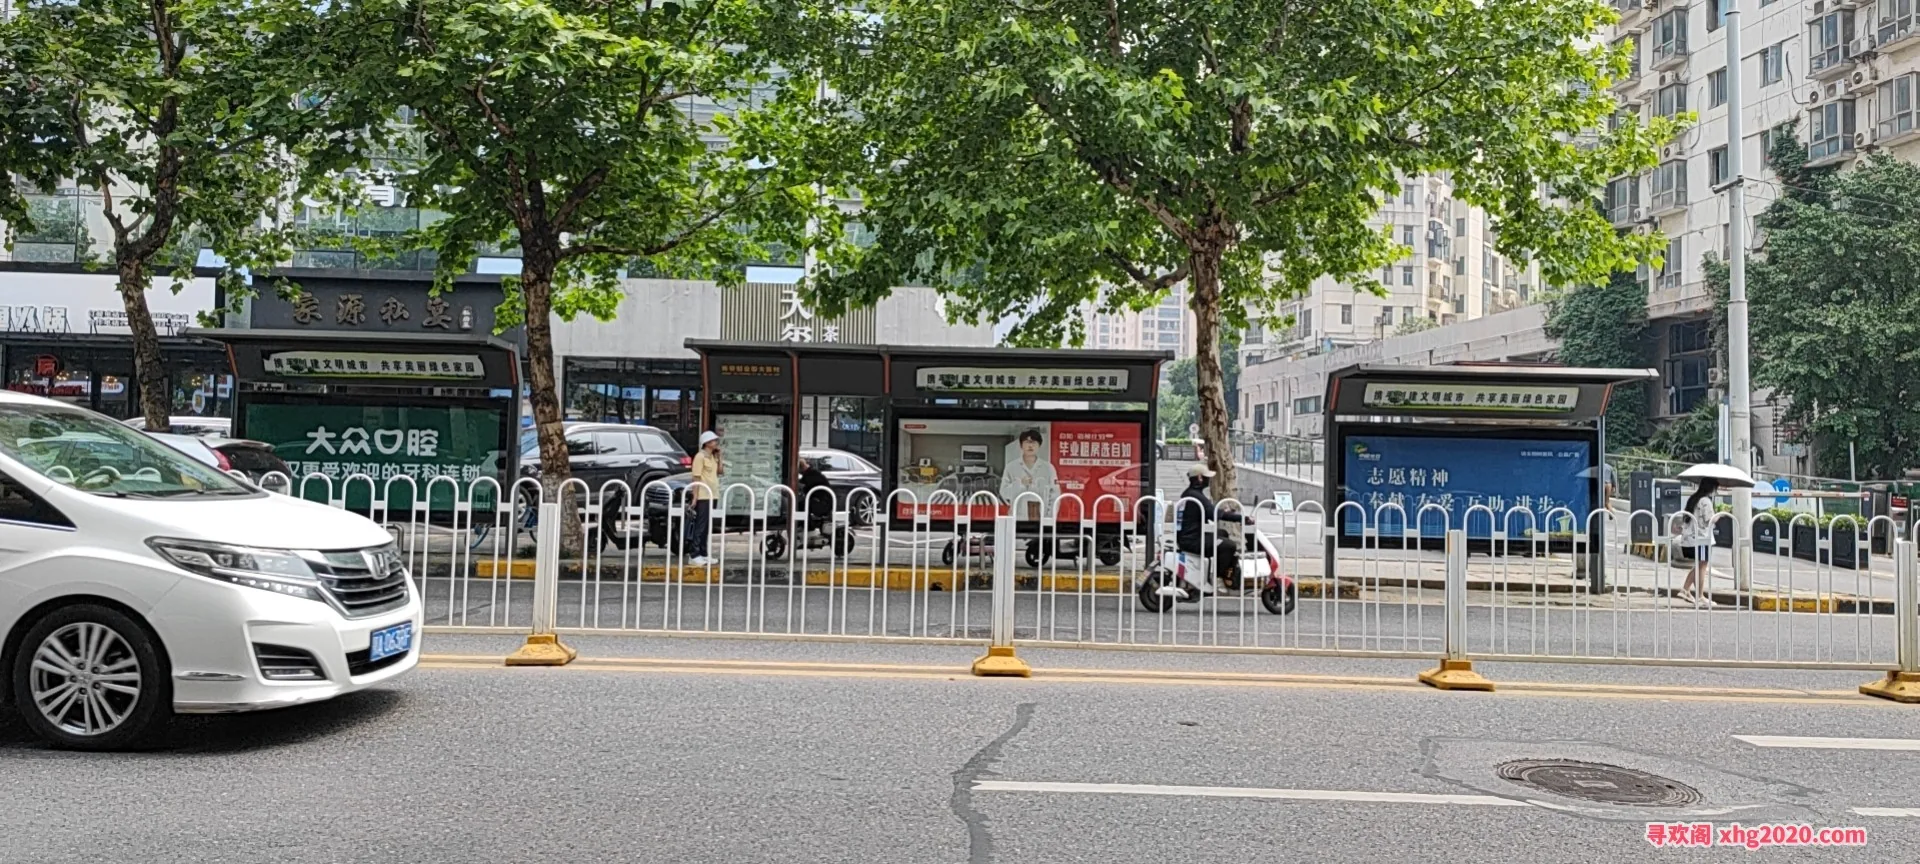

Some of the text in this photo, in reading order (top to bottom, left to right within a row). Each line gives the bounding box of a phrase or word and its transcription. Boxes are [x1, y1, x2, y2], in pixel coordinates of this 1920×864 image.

[293, 292, 452, 329] 家源私宴
[380, 359, 475, 372] 共享美丽绿色家园
[1027, 375, 1118, 387] 共享美丽绿色家园
[1475, 392, 1568, 405] 共享美丽绿色家园
[305, 425, 439, 457] 大众口腔
[1059, 441, 1132, 458] 毕业租房选自如
[1367, 467, 1449, 487] 志愿精神
[1514, 494, 1555, 514] 进步
